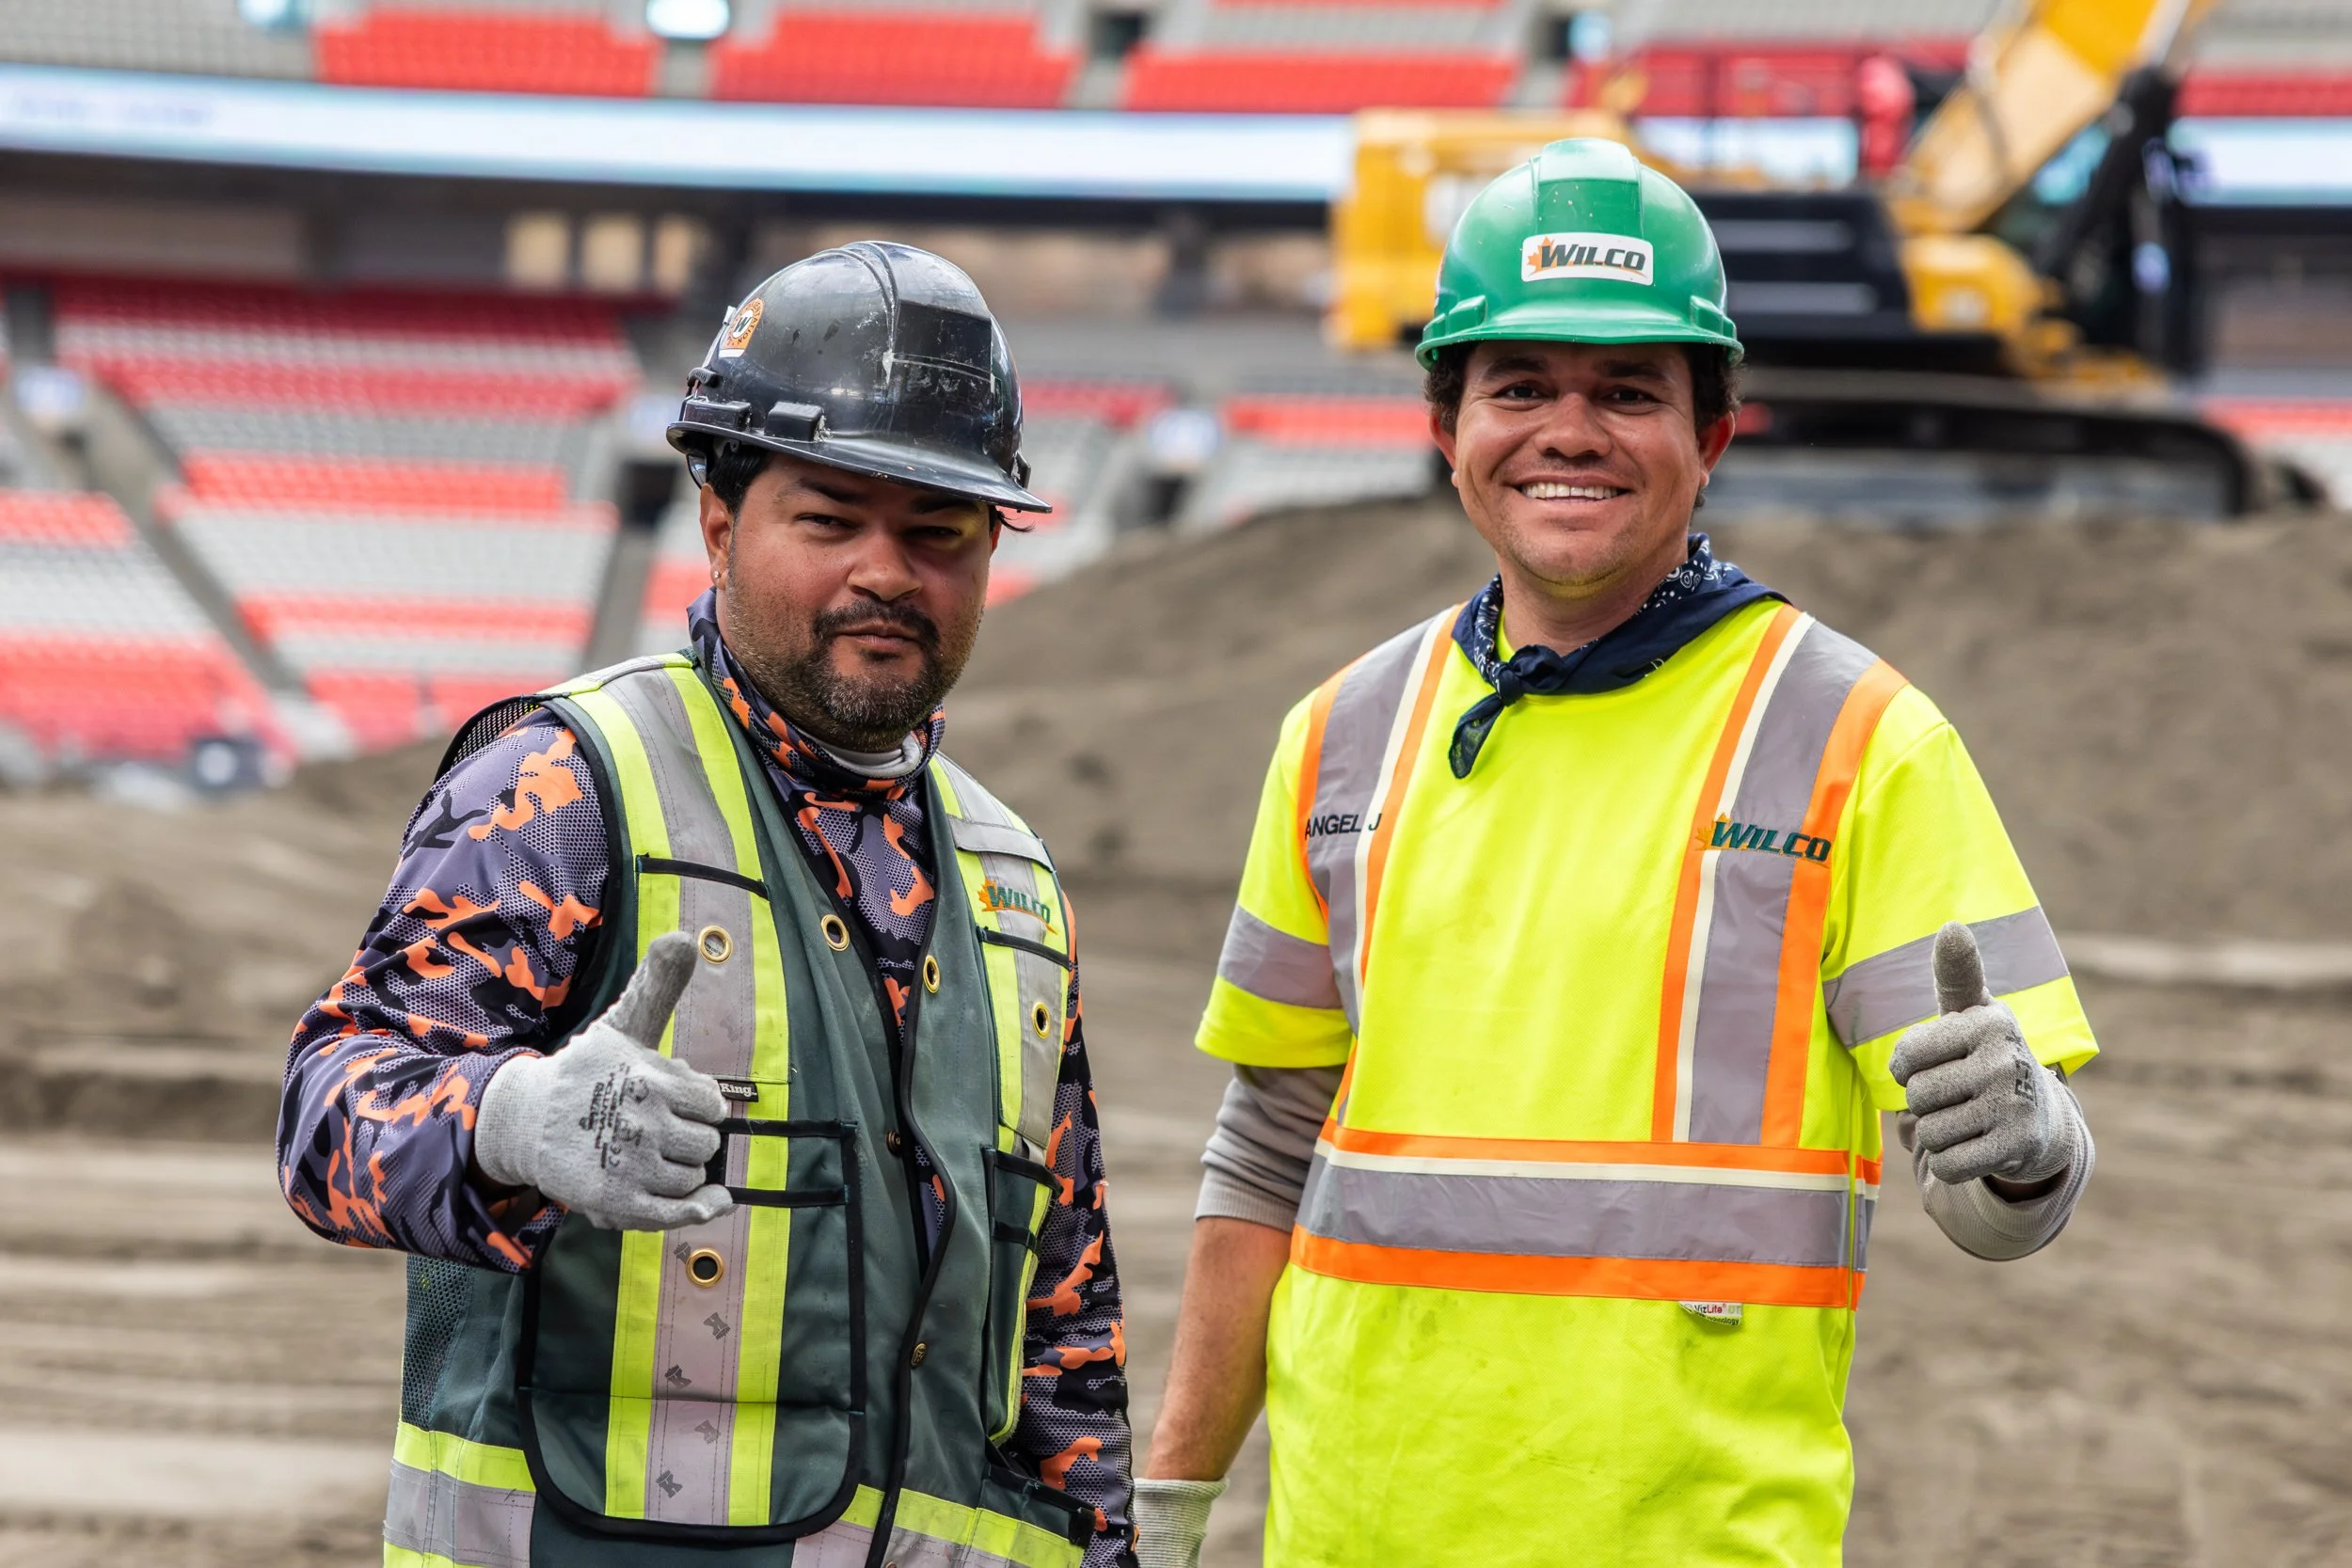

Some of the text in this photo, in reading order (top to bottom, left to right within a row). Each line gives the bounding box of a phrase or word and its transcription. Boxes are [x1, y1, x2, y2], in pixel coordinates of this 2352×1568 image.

[1541, 243, 1646, 271] WILCO
[734, 316, 753, 332] W
[1304, 813, 1382, 841] ANGEL J
[1710, 821, 1832, 863] WILCO
[987, 885, 1051, 924] WILCO
[719, 1083, 752, 1098] King
